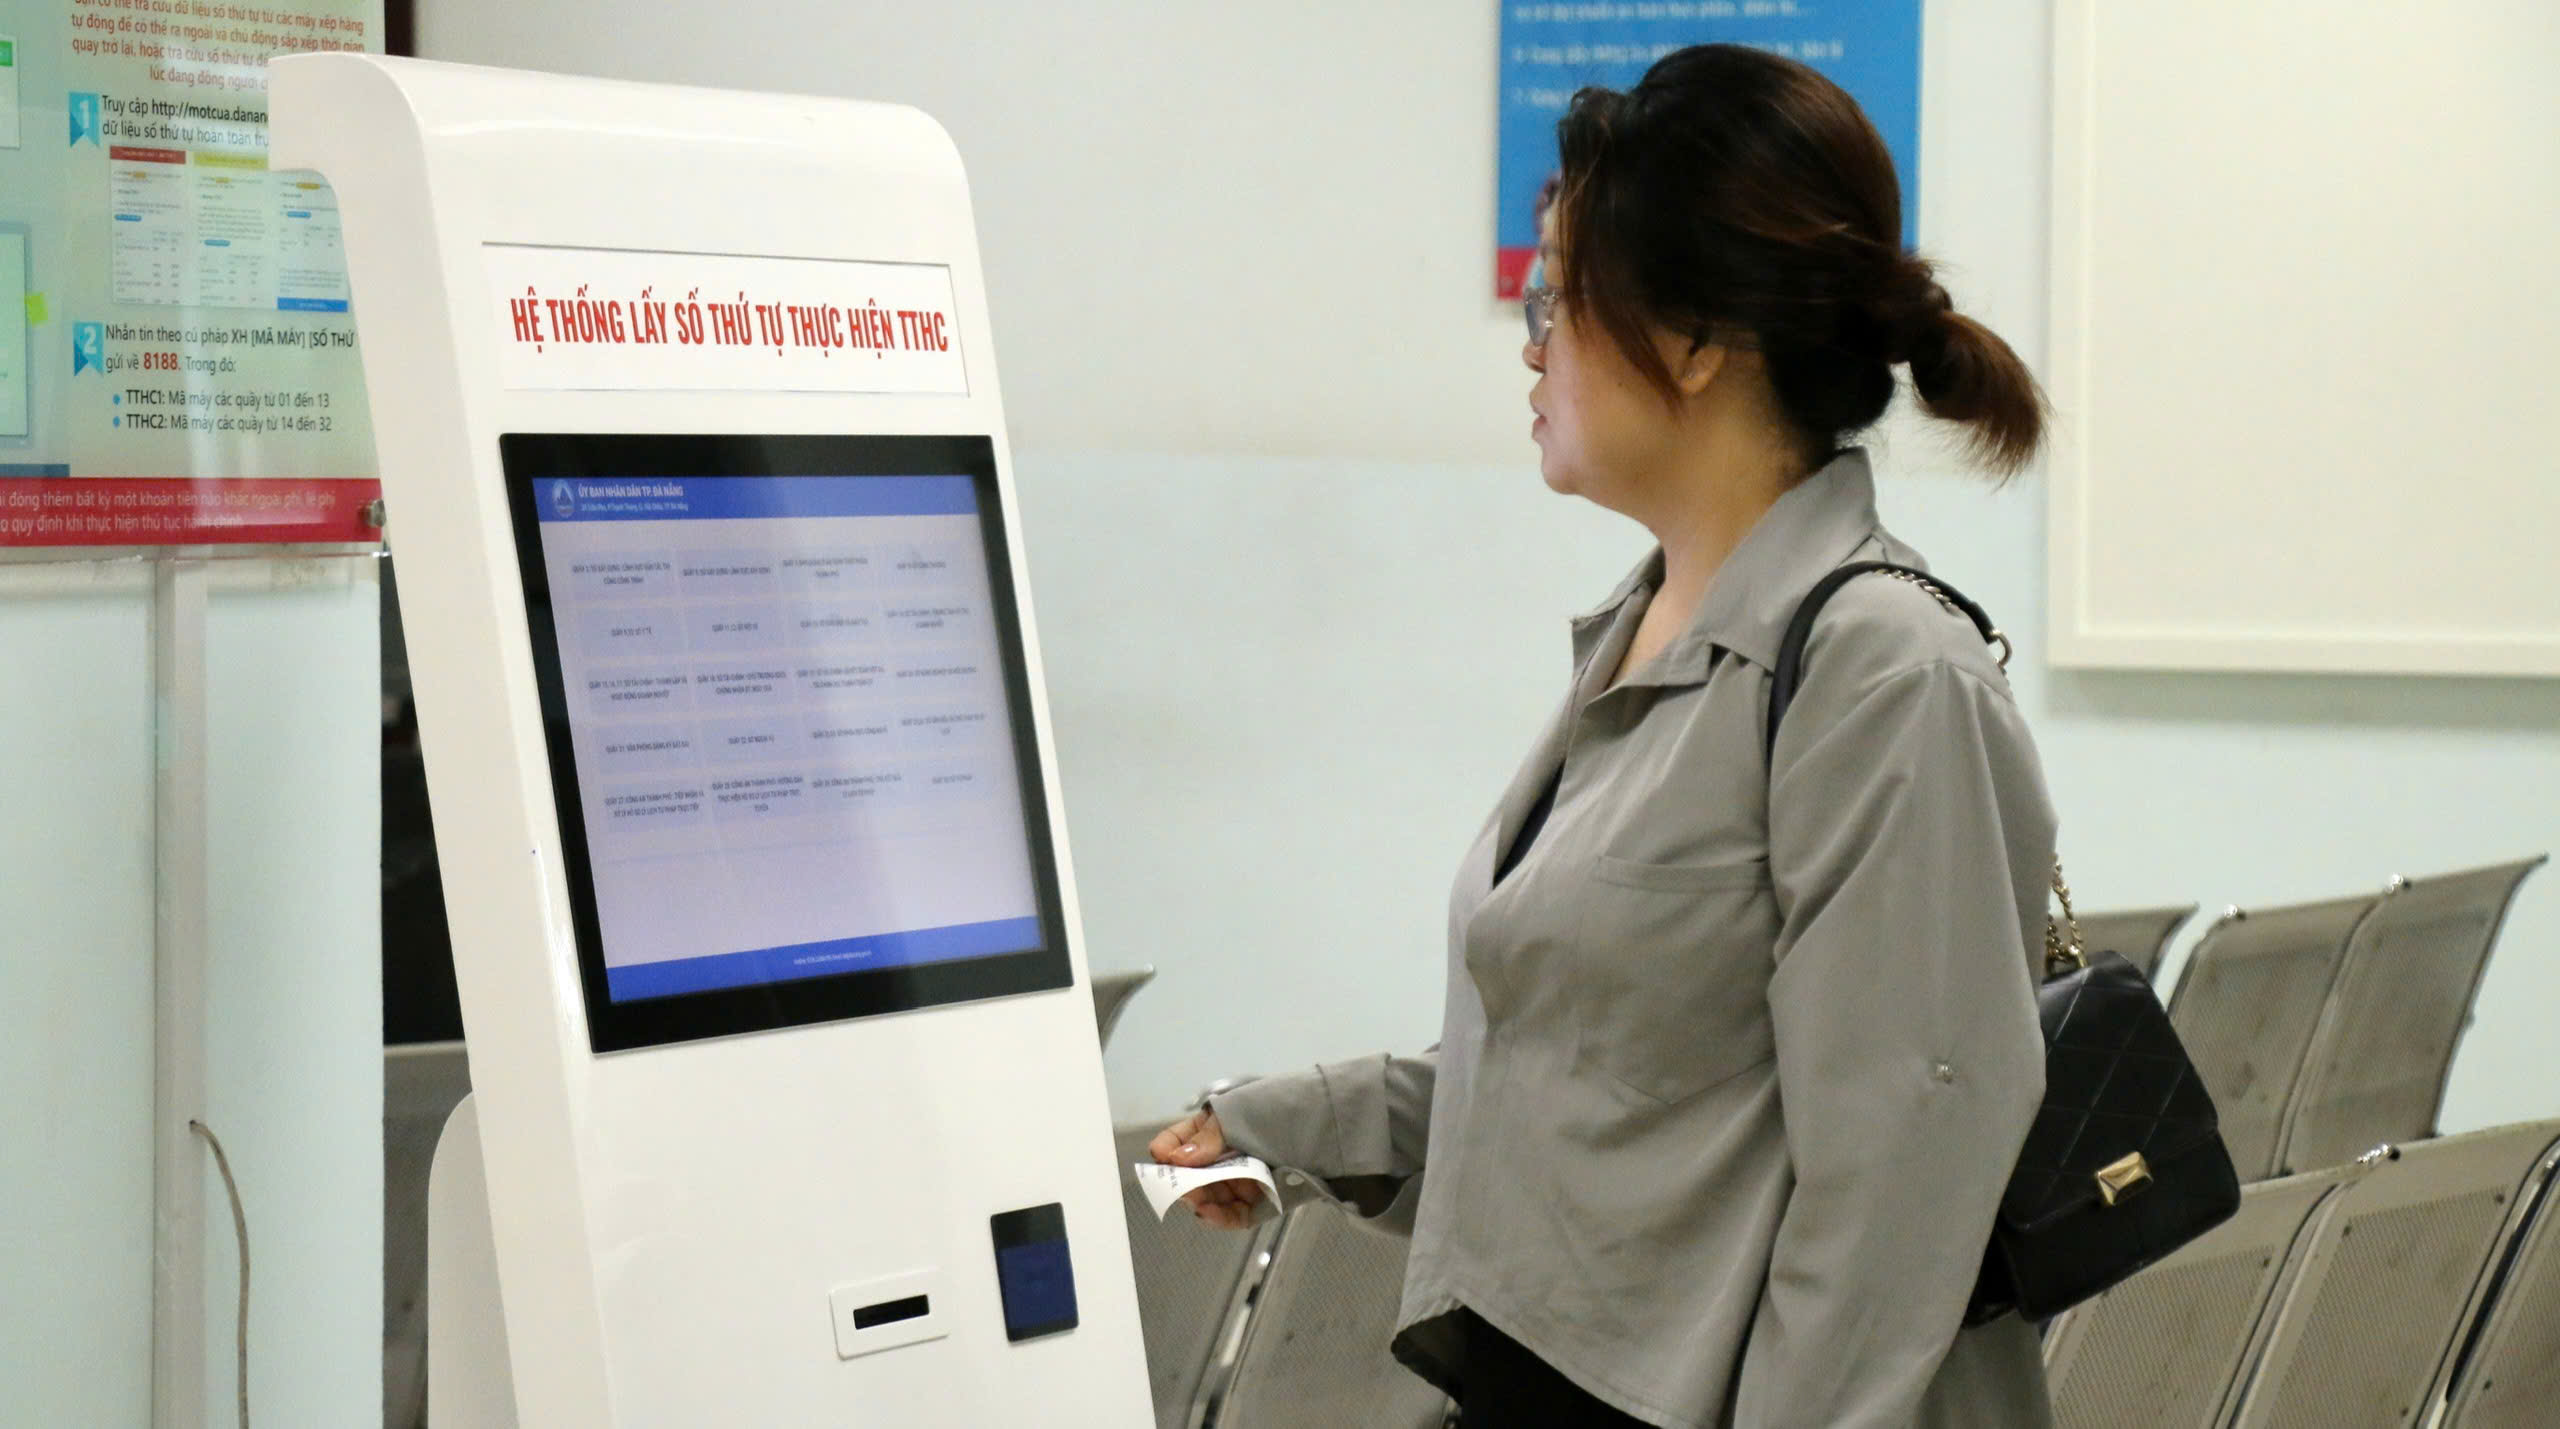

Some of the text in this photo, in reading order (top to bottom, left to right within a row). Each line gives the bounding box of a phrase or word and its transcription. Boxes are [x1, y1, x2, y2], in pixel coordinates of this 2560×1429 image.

[135, 0, 149, 11] tra
[339, 15, 364, 36] hàng
[72, 14, 83, 29] tự
[87, 14, 115, 34] động
[118, 15, 132, 32] để
[135, 18, 147, 33] có
[150, 18, 167, 35] thể
[171, 25, 181, 36] ra
[183, 23, 213, 42] ngoài
[216, 28, 227, 40] và
[230, 28, 248, 42] chủ
[251, 30, 278, 49] động
[72, 39, 99, 56] quay
[102, 38, 118, 53] trở
[121, 39, 136, 57] lại,
[140, 41, 165, 60] hoặc
[168, 45, 182, 60] tra
[185, 46, 204, 62] cứu
[207, 47, 219, 63] số
[149, 65, 165, 81] lúc
[79, 100, 91, 129] 1
[102, 95, 268, 123] Truy cập http://motcua.danan
[102, 120, 117, 135] dữ
[121, 121, 141, 140] liệu
[144, 122, 157, 138] số
[160, 124, 179, 140] thứ
[181, 126, 193, 143] tự
[198, 127, 223, 143] hoàn
[511, 284, 948, 359] HỆ THỐNG LẤY SỐ THỨ TỰ THỰC HIỆN TTHC
[83, 325, 97, 355] 2
[106, 323, 355, 349] Nhắn tin theo cú pháp XH [MÃ MÁY] [SỐ THỨ
[105, 352, 236, 376] gửi về 8188. Trong đó:
[126, 389, 330, 412] TTHC1: Mã máy các quầy từ 01 đến 13
[126, 414, 332, 434] TTHC2: Mã máy các quầy từ 14 đến 32
[8, 491, 40, 511] đóng
[43, 491, 73, 506] thêm
[76, 490, 95, 507] bất
[114, 491, 137, 509] một
[140, 491, 174, 506] khoản
[11, 518, 34, 537] quy
[37, 514, 63, 534] định
[66, 514, 83, 531] khi
[86, 514, 111, 534] thực
[115, 514, 139, 532] hiện
[142, 514, 160, 530] thủ
